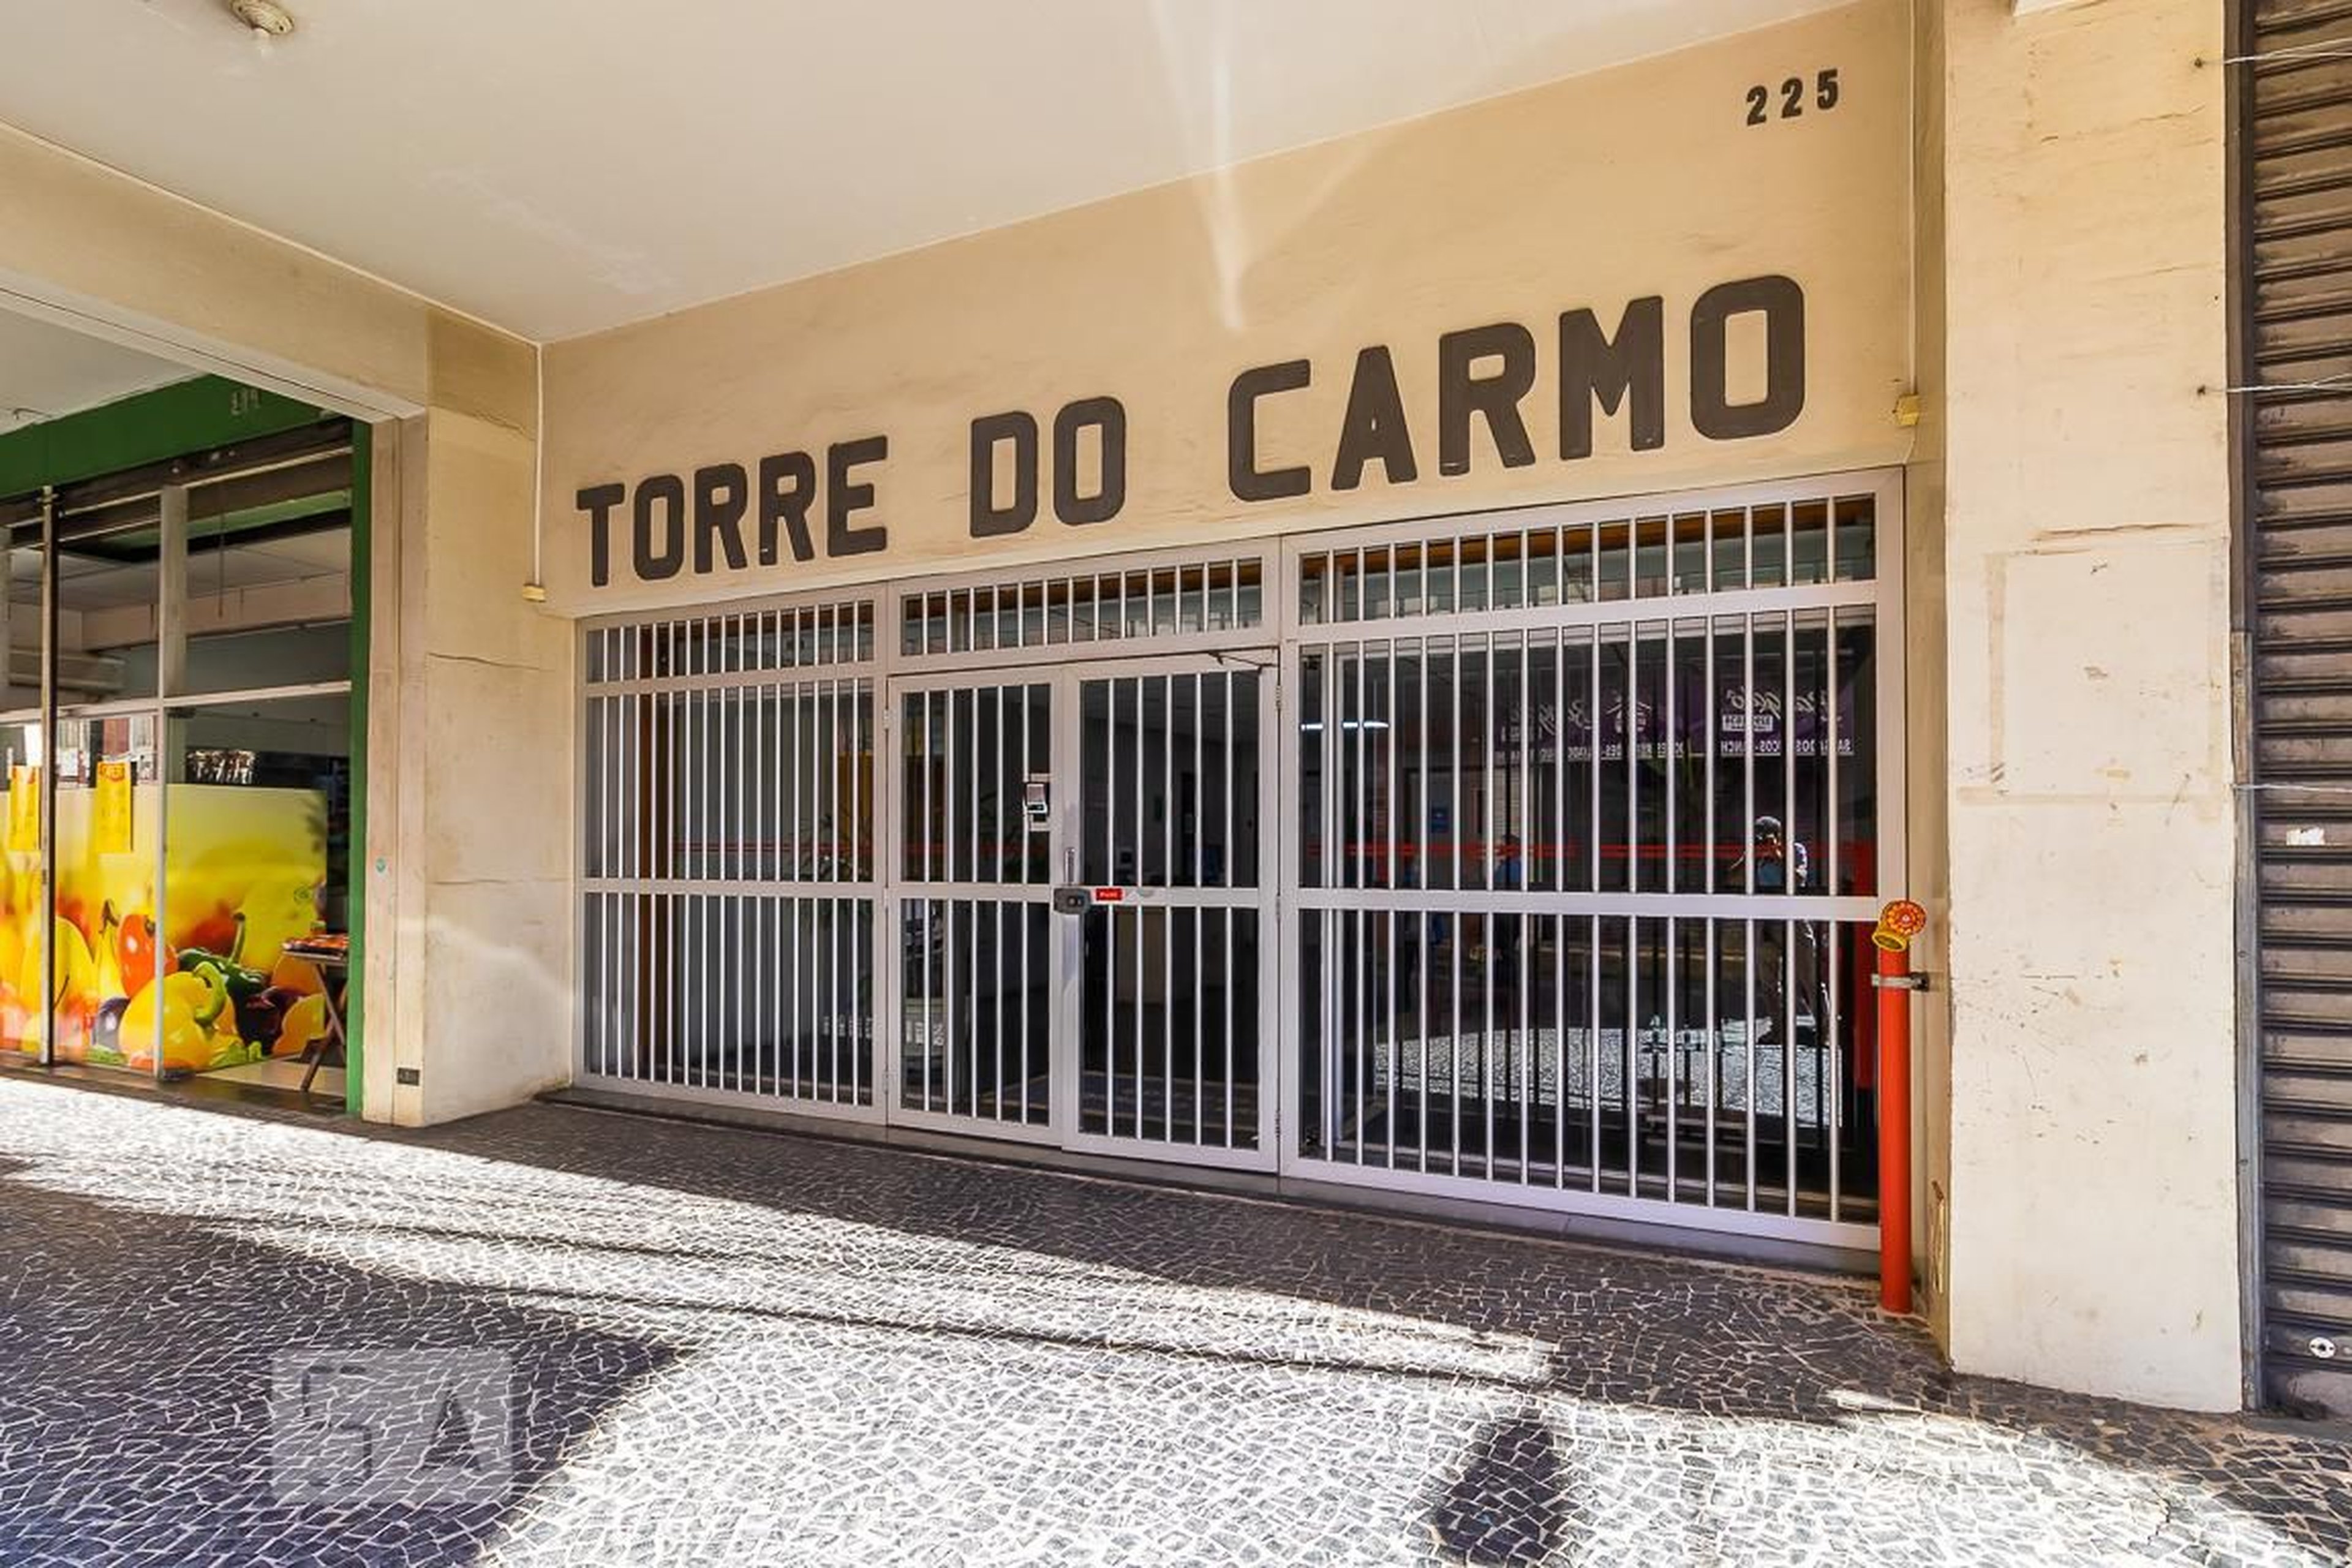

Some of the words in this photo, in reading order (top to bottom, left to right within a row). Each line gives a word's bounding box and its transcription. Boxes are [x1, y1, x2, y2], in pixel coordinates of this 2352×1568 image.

[1746, 67, 1839, 126] 225
[575, 434, 889, 589] TORRE
[969, 395, 1127, 539] DO
[1227, 274, 1806, 503] CARMO
